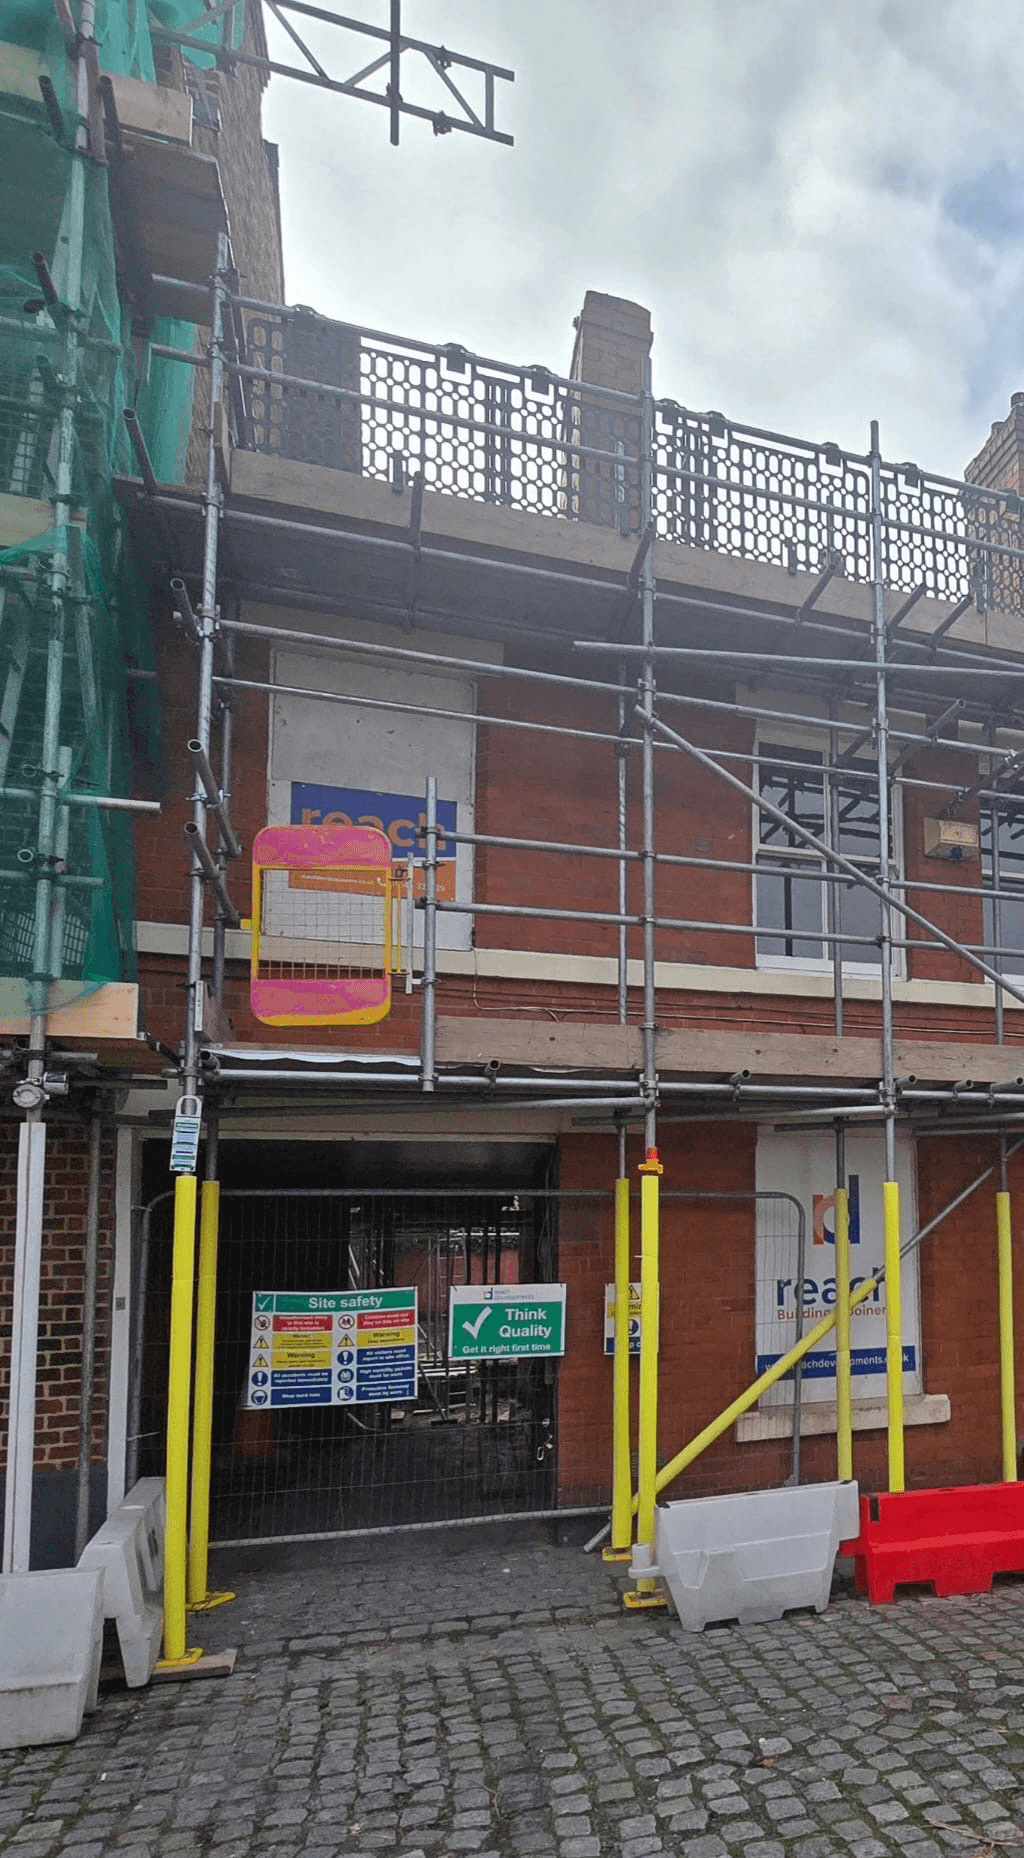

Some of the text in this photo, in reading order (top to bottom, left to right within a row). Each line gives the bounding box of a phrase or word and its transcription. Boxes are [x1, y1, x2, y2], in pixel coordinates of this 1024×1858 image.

[308, 1295, 383, 1309] Site safety
[505, 1308, 547, 1321] Think
[777, 1305, 887, 1320] Buding Joiner
[498, 1324, 552, 1338] Quality
[462, 1342, 551, 1354] Get it right first time
